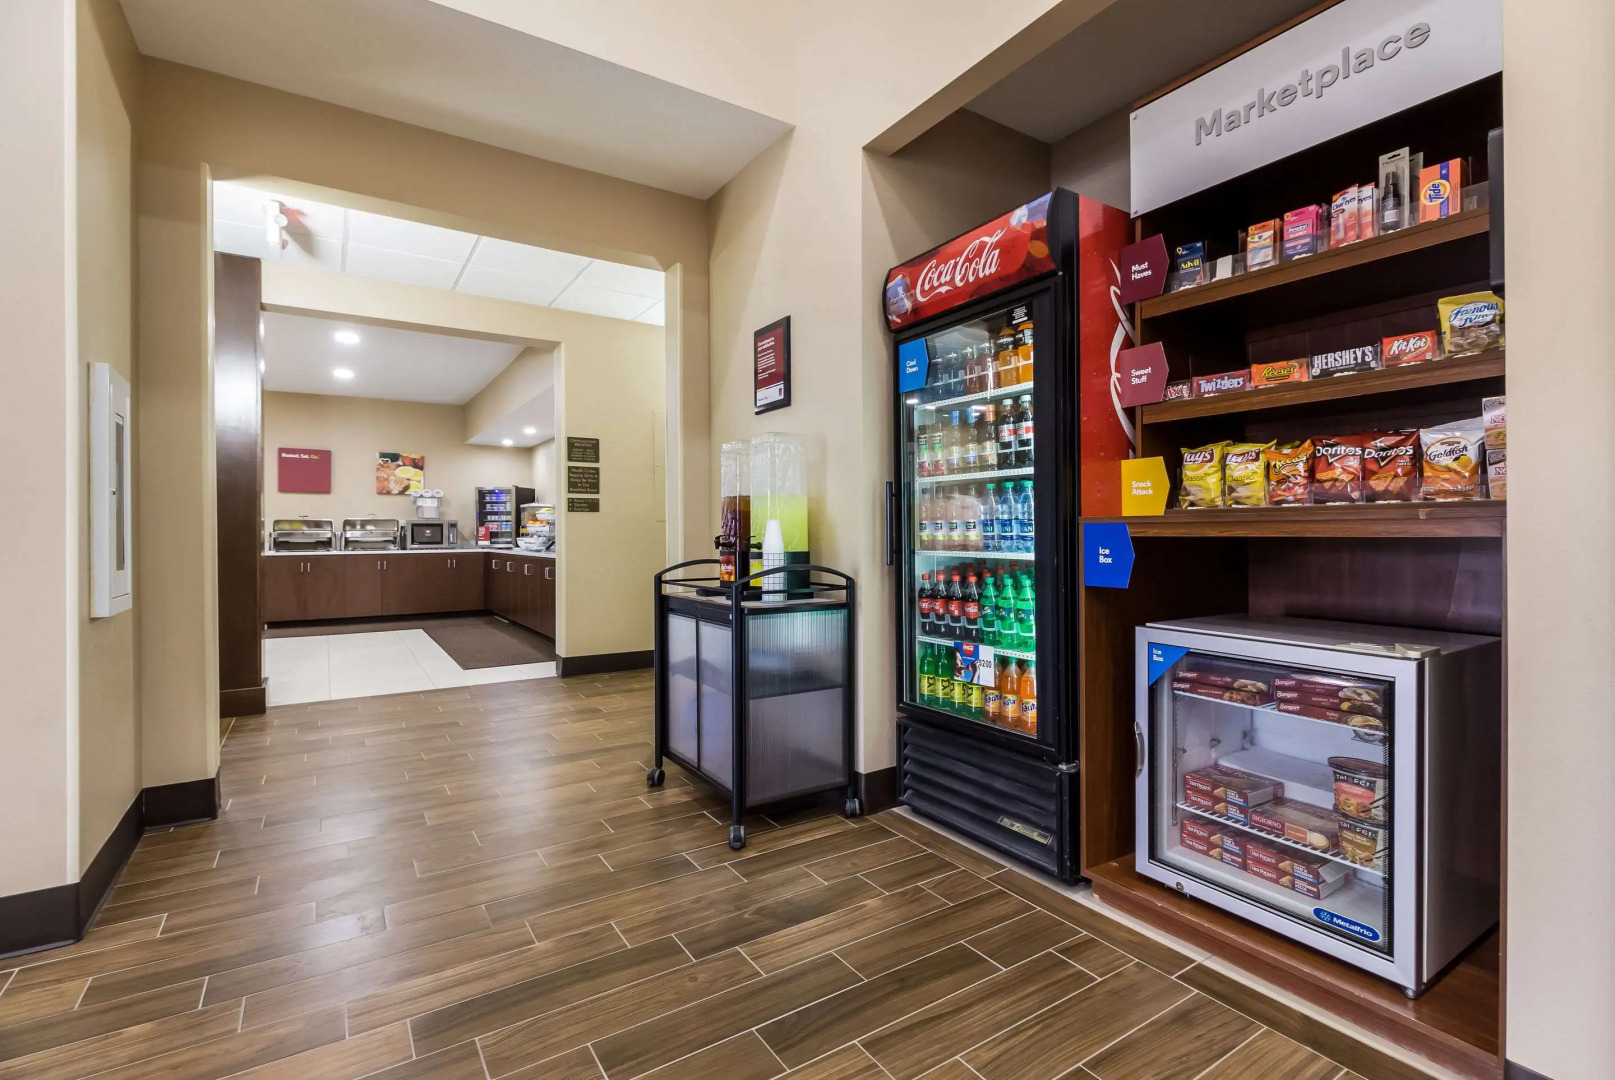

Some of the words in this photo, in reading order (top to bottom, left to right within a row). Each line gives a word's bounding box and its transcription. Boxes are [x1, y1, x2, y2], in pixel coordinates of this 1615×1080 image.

[1195, 22, 1431, 146] Marketplace
[1428, 183, 1445, 203] Tide
[916, 226, 1008, 302] Coca-Cola
[1131, 261, 1149, 273] Must
[1180, 259, 1199, 269] Advil
[1131, 270, 1152, 281] Haves
[1449, 302, 1499, 323] Famous
[906, 358, 917, 367] Cool
[1312, 345, 1373, 370] HERSHEY'S
[906, 366, 919, 374] Down
[1131, 366, 1152, 377] Sweet
[1131, 375, 1147, 385] Stuff
[1199, 376, 1244, 393] Twizzlers
[1316, 445, 1362, 457] Doritos
[1364, 445, 1414, 459] Doritos
[1429, 444, 1468, 462] Goldfish
[1132, 480, 1151, 488] Snack
[1132, 488, 1154, 496] Attack
[1099, 546, 1110, 555] Ice
[1099, 555, 1112, 564] Box
[1333, 917, 1373, 937] Metalfrio
